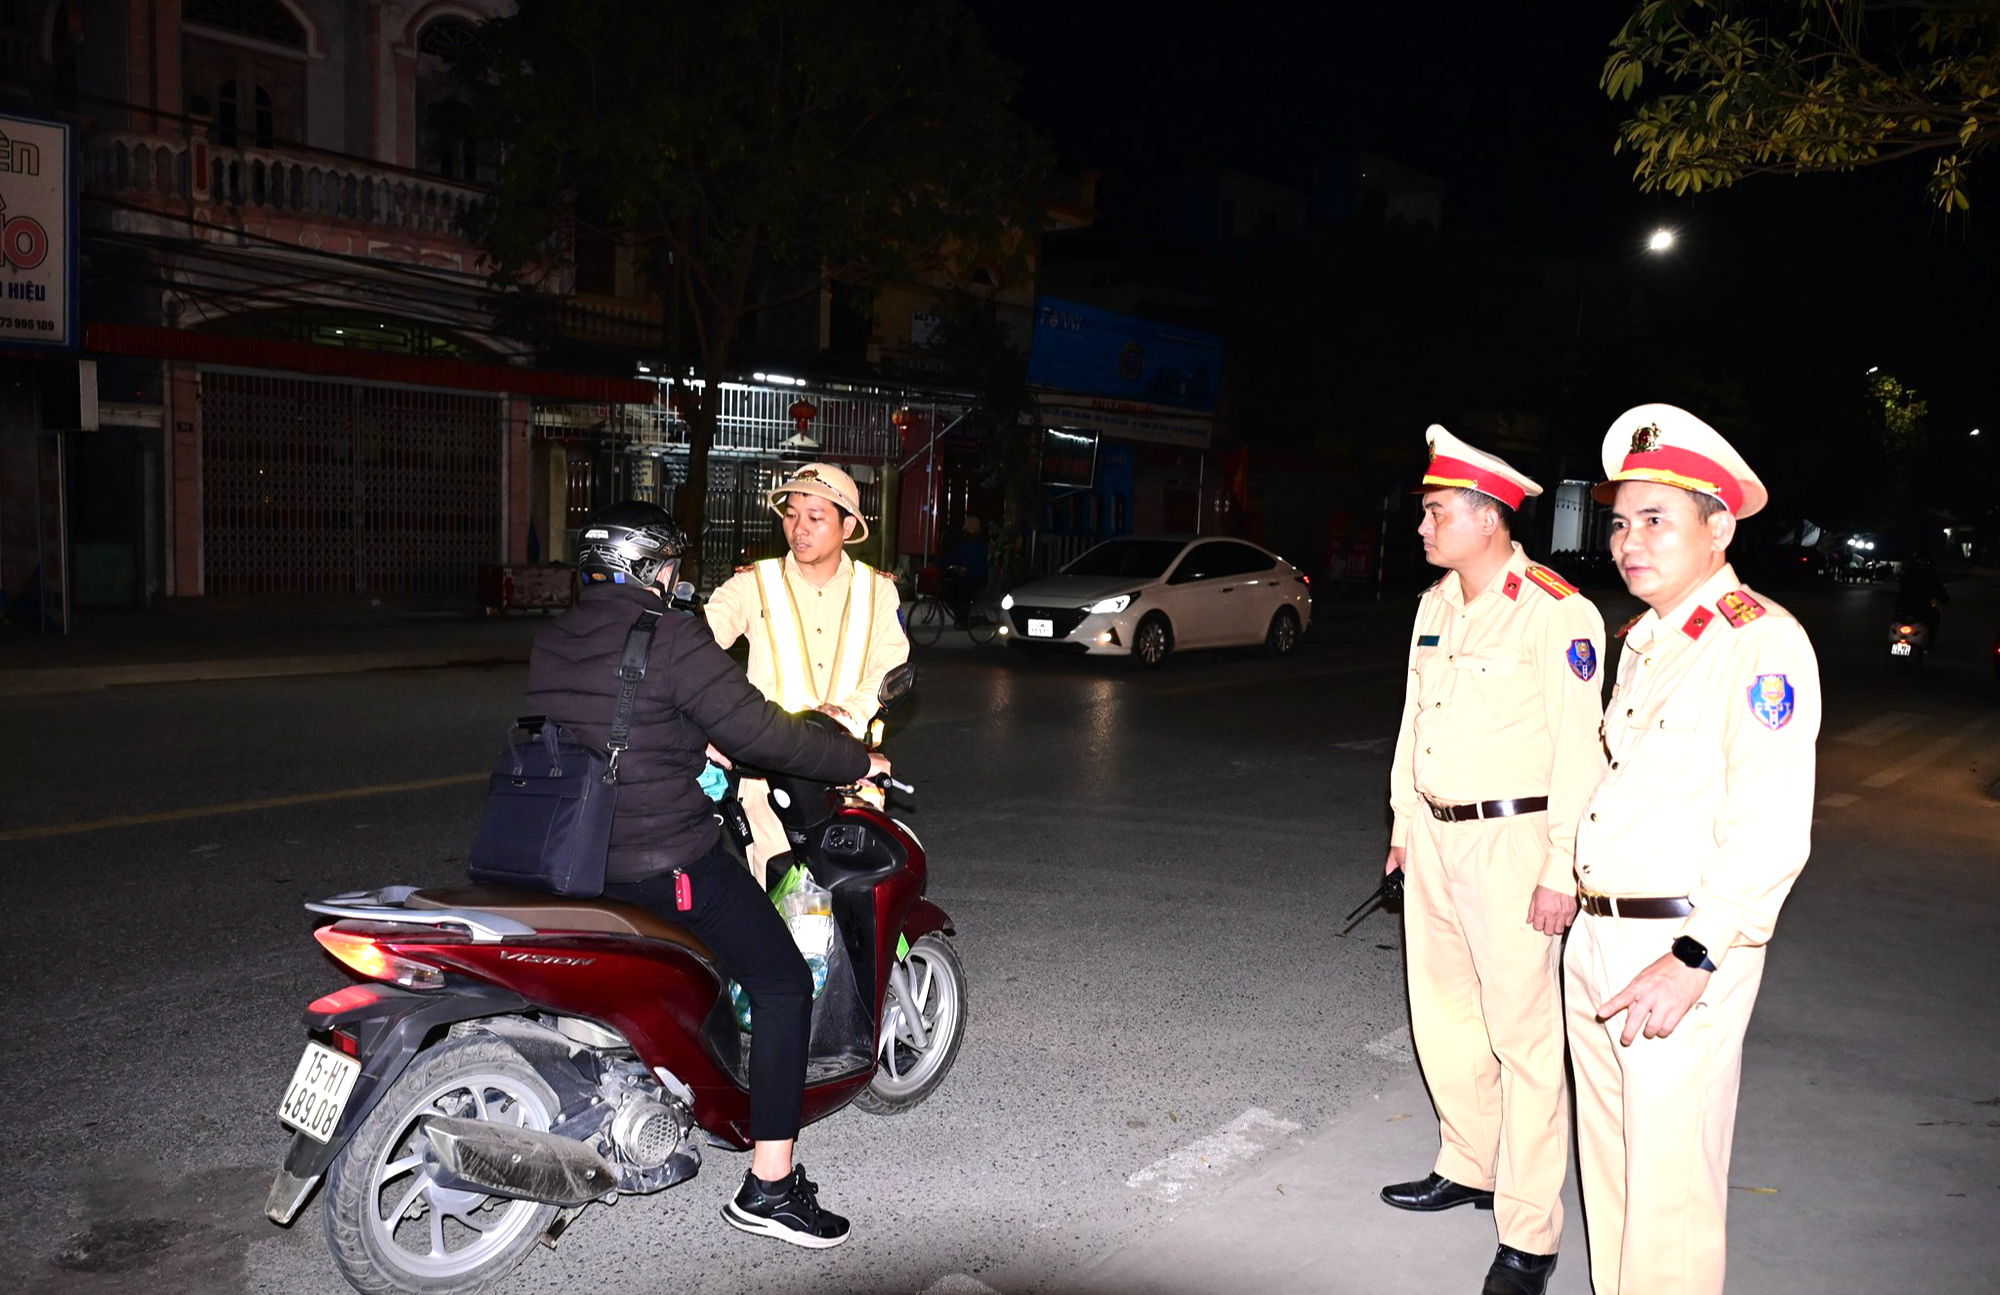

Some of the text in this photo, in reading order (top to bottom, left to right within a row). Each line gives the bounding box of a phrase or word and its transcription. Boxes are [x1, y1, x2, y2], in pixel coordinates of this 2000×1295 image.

[8, 280, 46, 303] HIỆU
[14, 317, 34, 330] 995
[36, 319, 55, 332] 189
[619, 682, 635, 715] SINCE
[500, 949, 597, 967] VISION
[304, 1050, 349, 1097] 15-H1
[283, 1082, 339, 1136] 489.08
